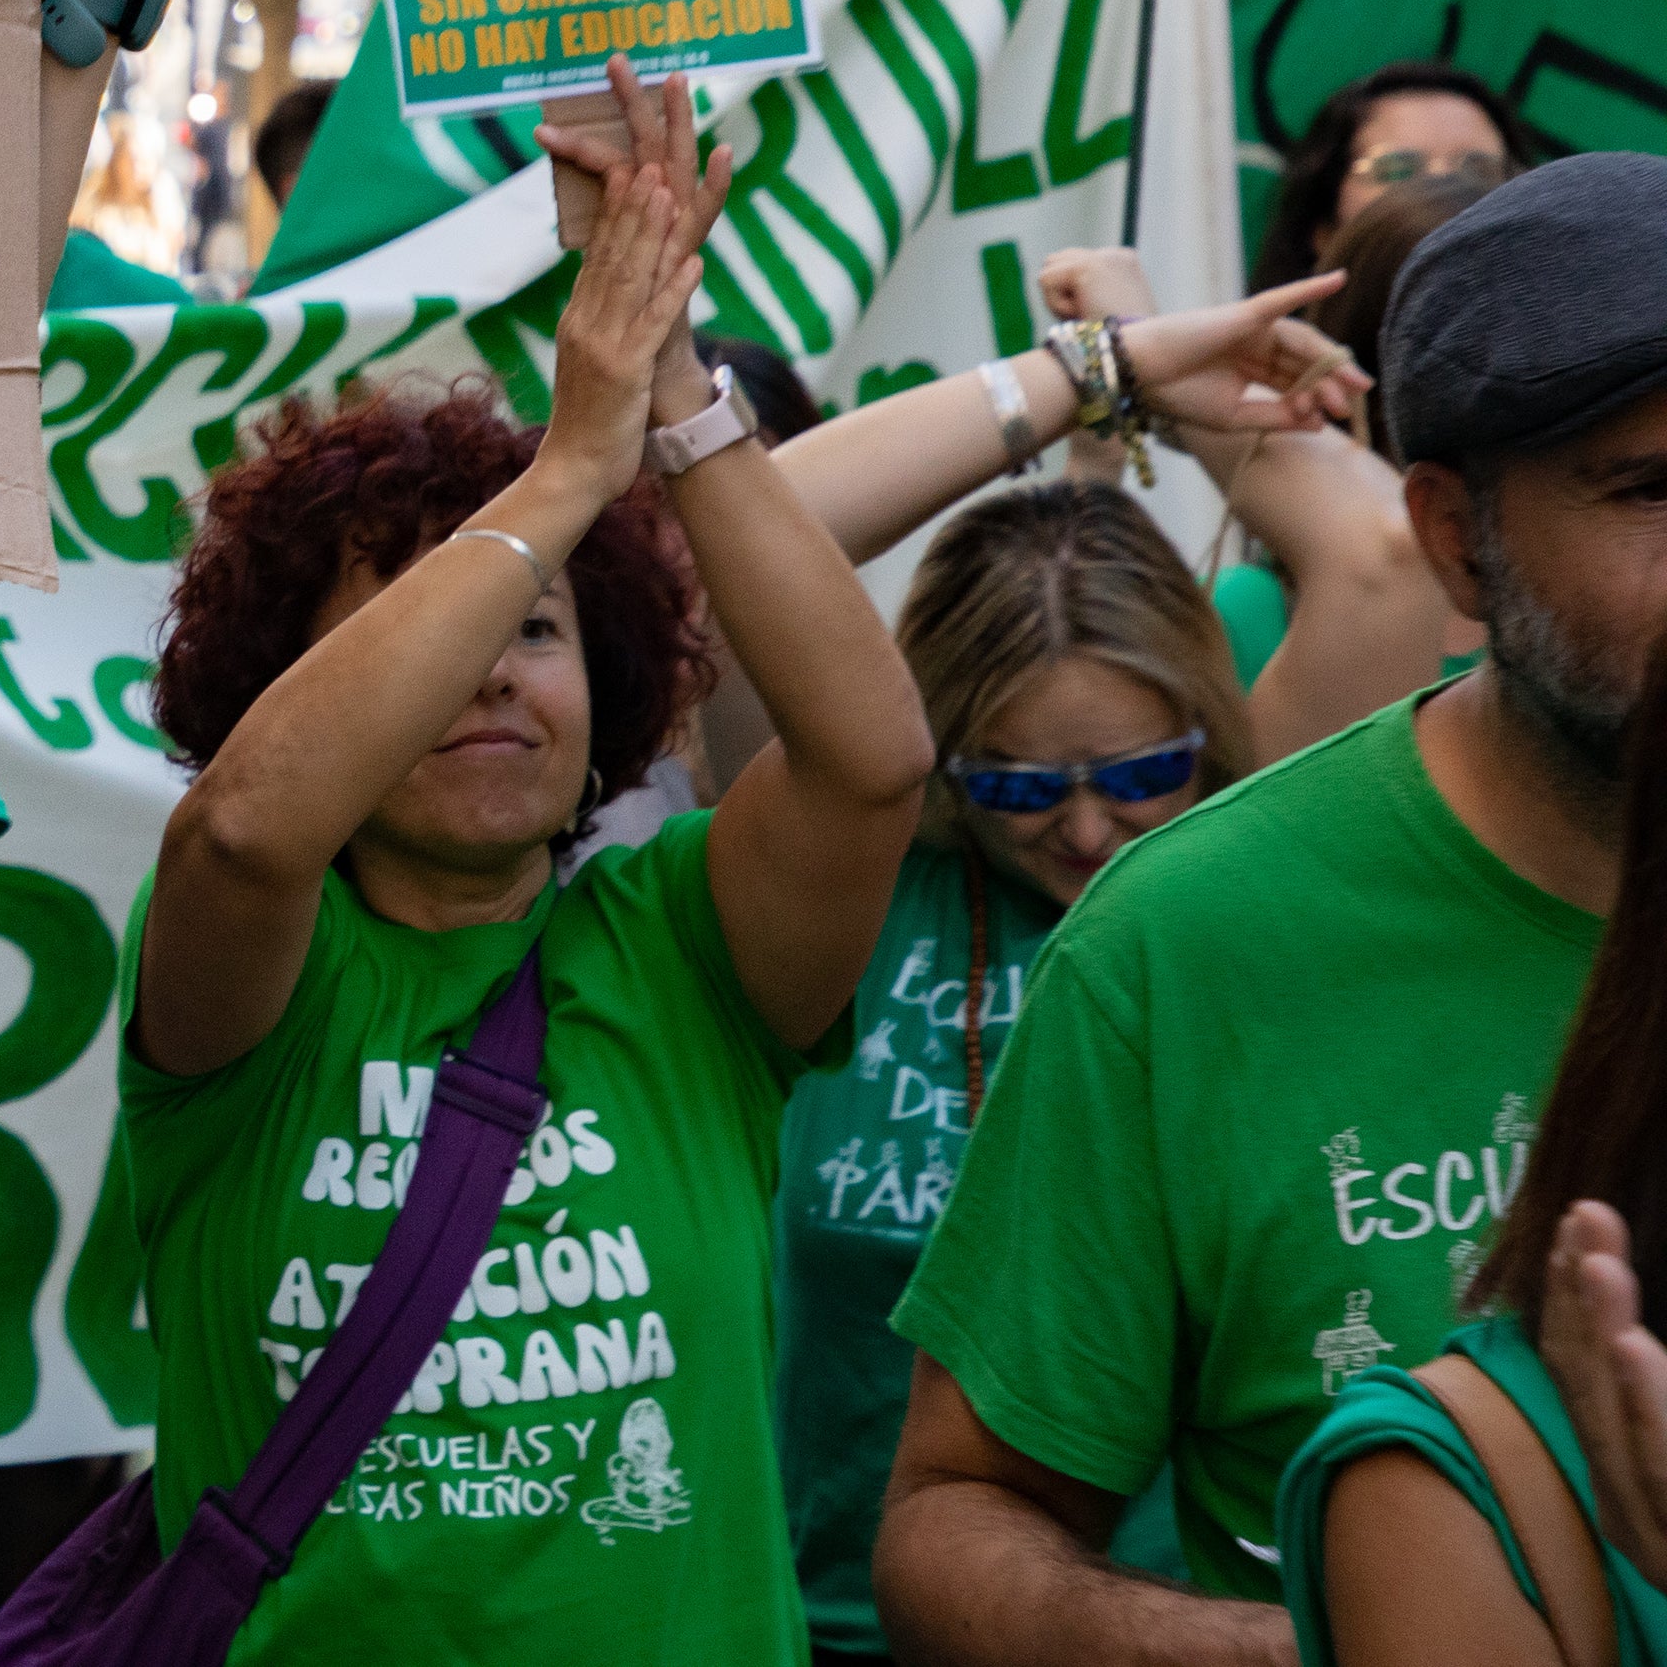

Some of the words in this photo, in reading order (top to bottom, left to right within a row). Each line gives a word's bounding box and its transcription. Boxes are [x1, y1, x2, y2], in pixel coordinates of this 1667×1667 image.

[409, 29, 466, 77] NO
[474, 17, 548, 68] HAY
[268, 1207, 651, 1330] ATCIÓN
[260, 1311, 676, 1414] TPRANA
[359, 1425, 553, 1473] ESCUELAS
[563, 1418, 597, 1460] Y
[440, 1474, 577, 1518] NIÑOS
